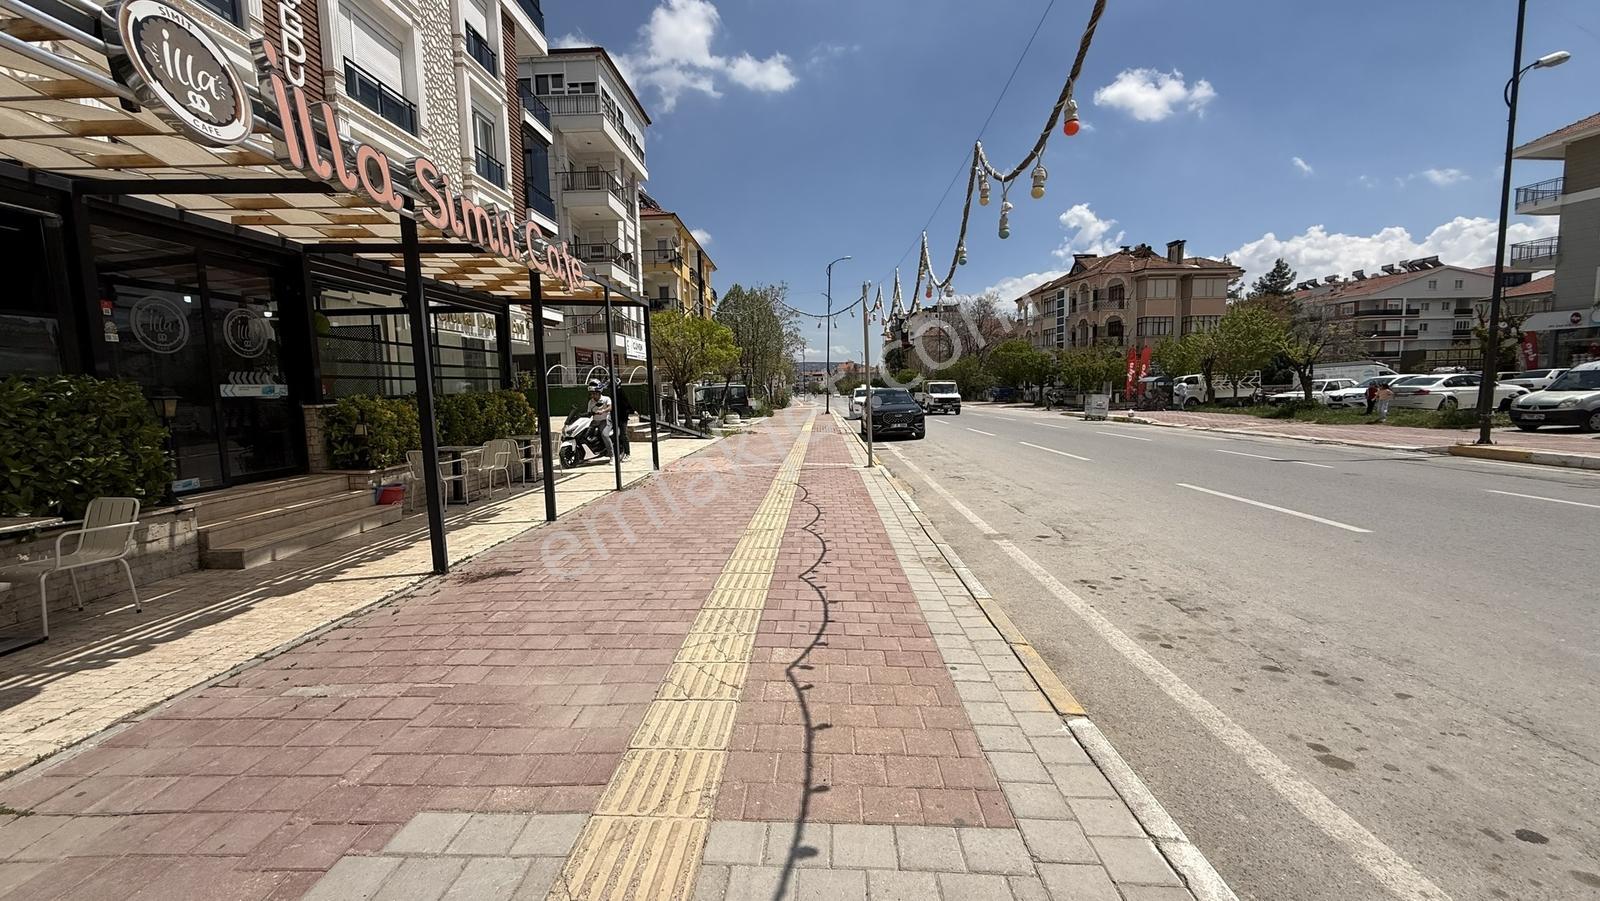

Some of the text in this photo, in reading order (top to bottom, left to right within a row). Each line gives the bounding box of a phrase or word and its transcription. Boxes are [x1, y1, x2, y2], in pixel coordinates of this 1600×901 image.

[161, 28, 220, 101] illa
[192, 118, 222, 137] CAFE
[263, 40, 586, 294] illa Simit Cafe
